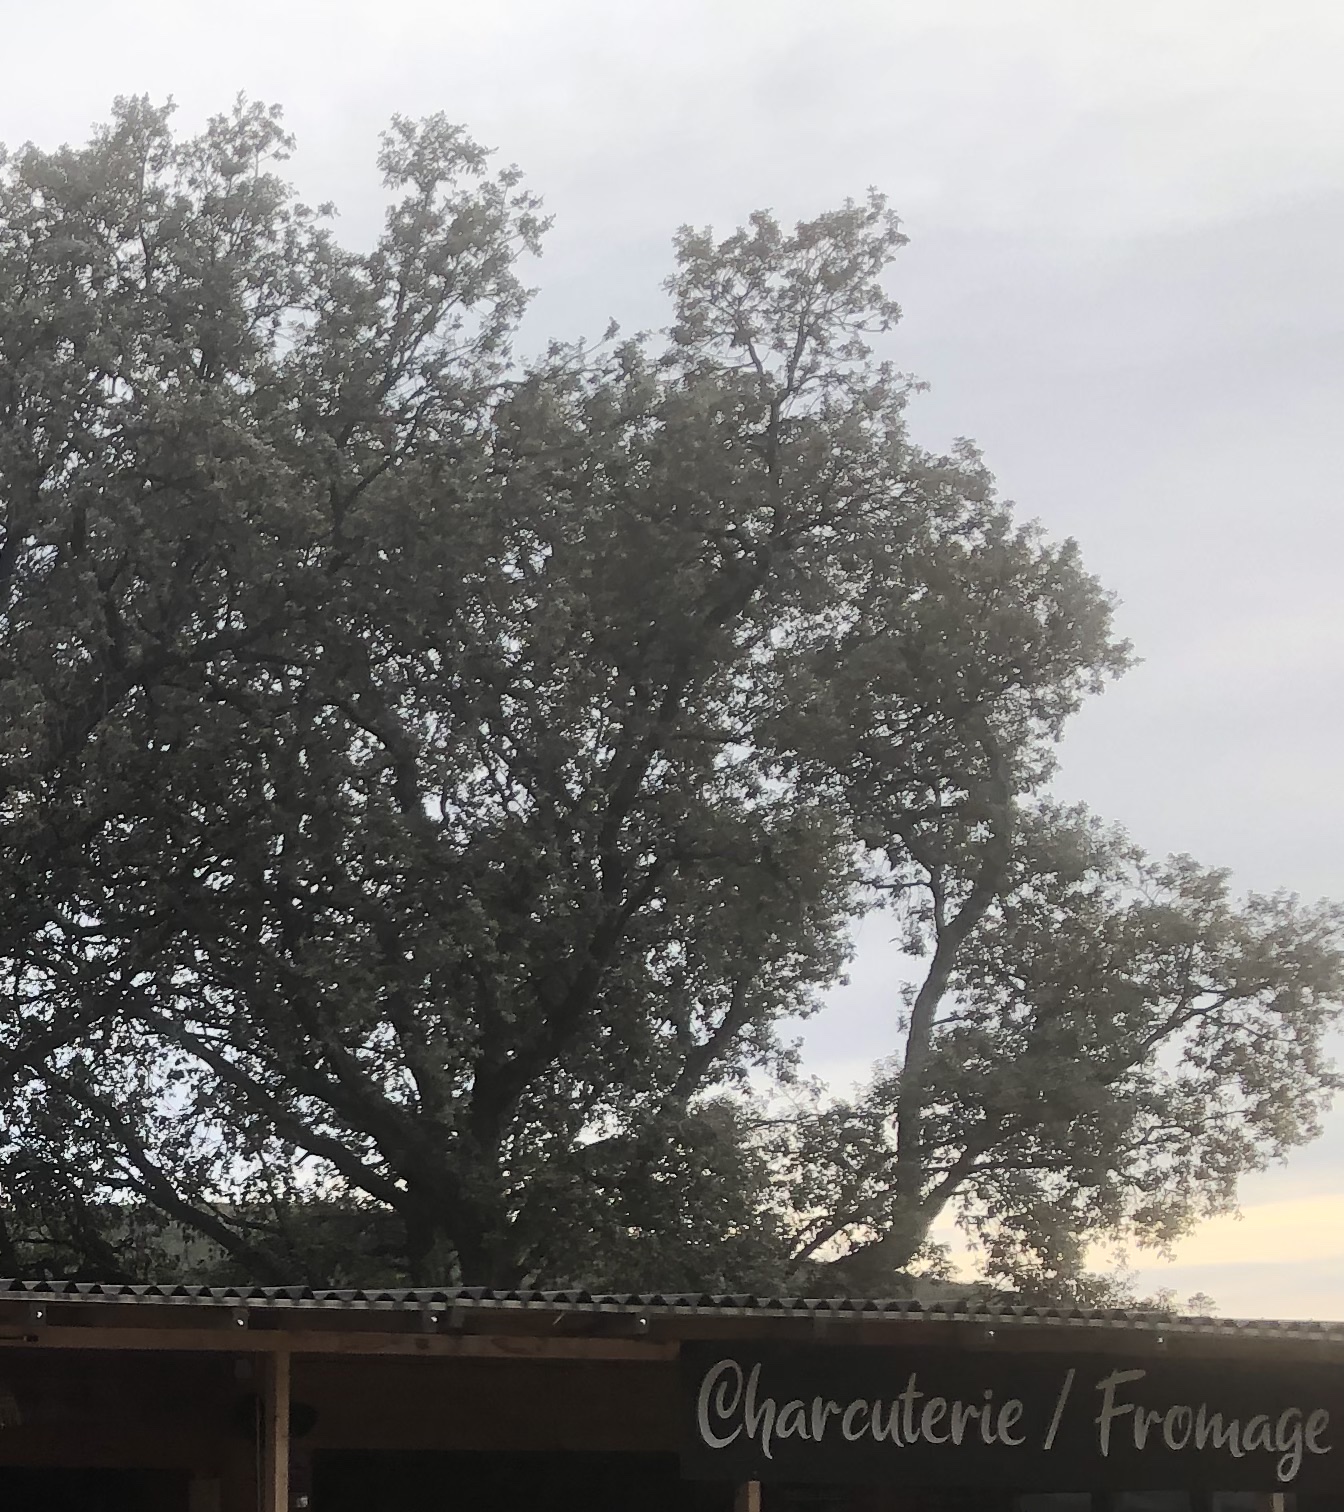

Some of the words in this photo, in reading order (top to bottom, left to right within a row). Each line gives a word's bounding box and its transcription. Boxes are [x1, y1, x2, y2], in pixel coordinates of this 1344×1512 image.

[697, 1358, 1026, 1461] Charcuterie
[1043, 1368, 1076, 1450] /
[1095, 1368, 1332, 1483] Fromage
